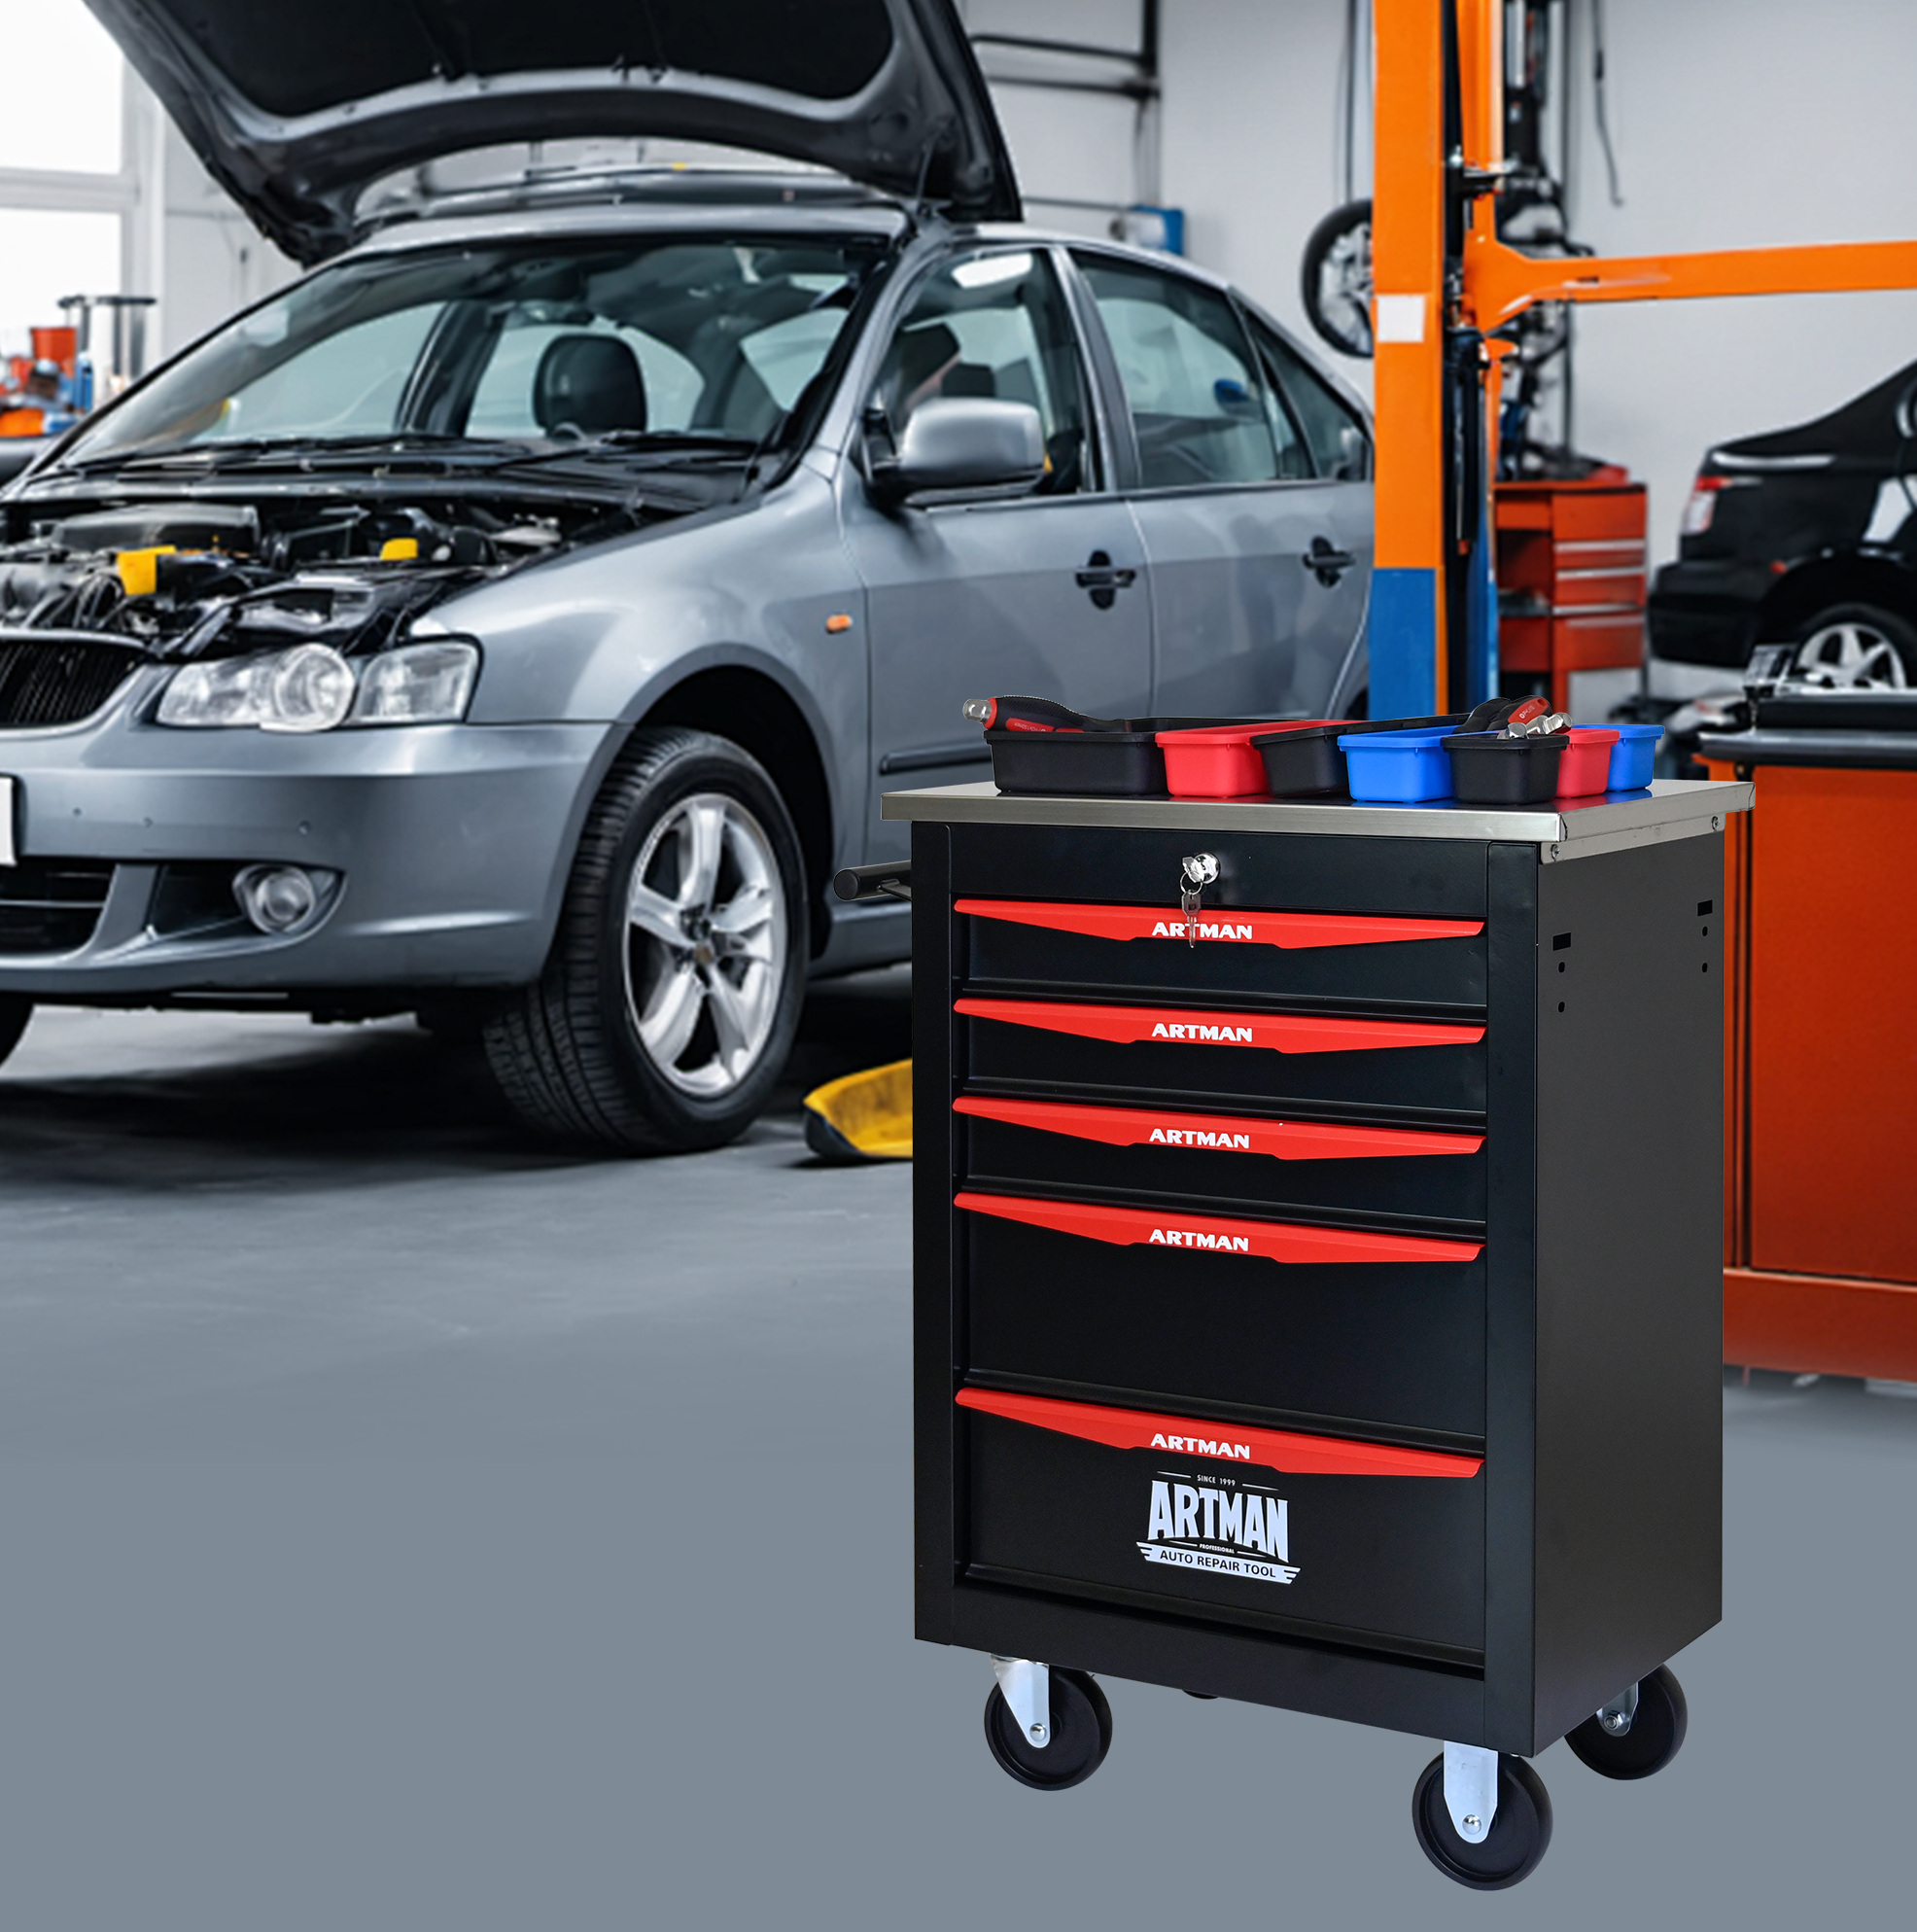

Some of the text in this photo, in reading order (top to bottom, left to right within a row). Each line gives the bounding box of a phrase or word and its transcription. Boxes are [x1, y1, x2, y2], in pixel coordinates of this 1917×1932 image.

[1151, 1023, 1253, 1042] ARTMAN
[1149, 1128, 1250, 1149] ARTMAN
[1149, 1229, 1249, 1252] ARTMAN
[1151, 1433, 1250, 1459] ARTMAN
[1197, 1474, 1237, 1487] SINCE 1999
[1147, 1480, 1289, 1563] ARTMAN
[1160, 1550, 1276, 1578] AUTO REPAIR TOOL
